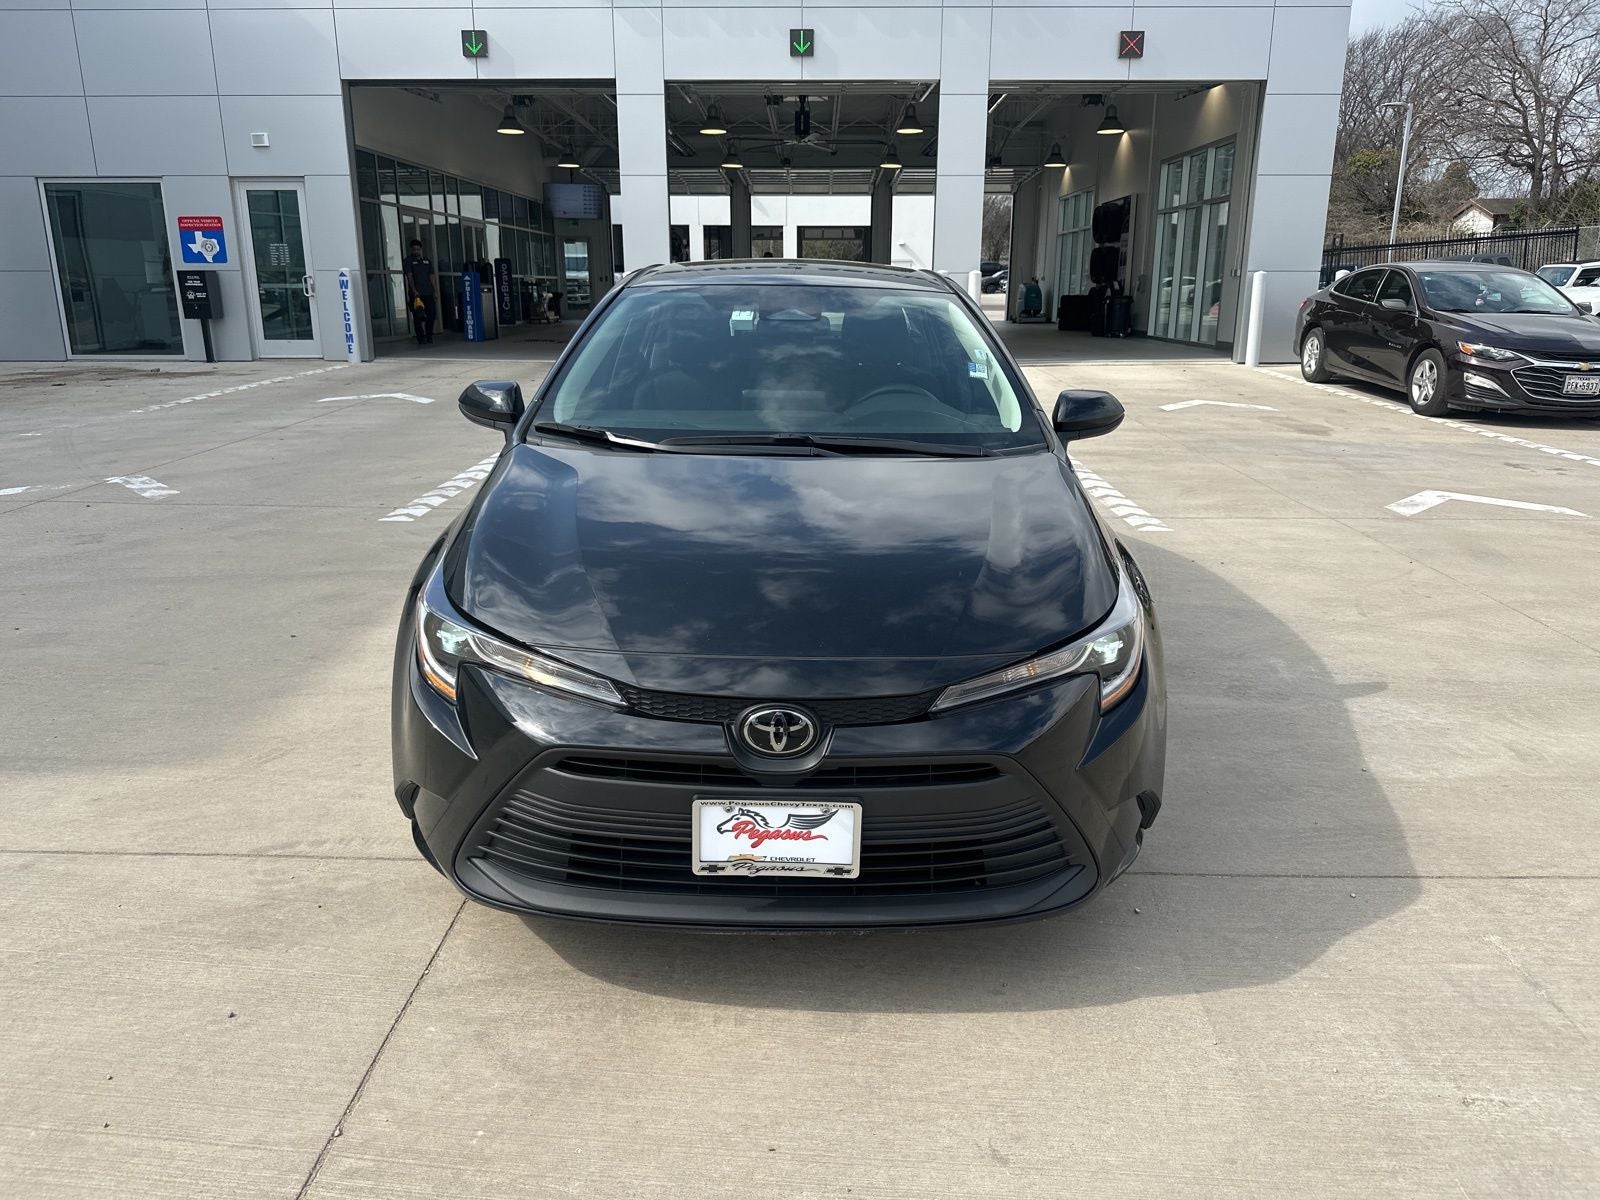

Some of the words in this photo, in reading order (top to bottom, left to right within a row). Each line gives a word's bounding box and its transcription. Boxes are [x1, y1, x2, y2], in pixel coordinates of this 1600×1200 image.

[501, 263, 511, 310] CarBravo
[339, 279, 354, 354] WELCOME
[731, 820, 828, 848] Pegasus
